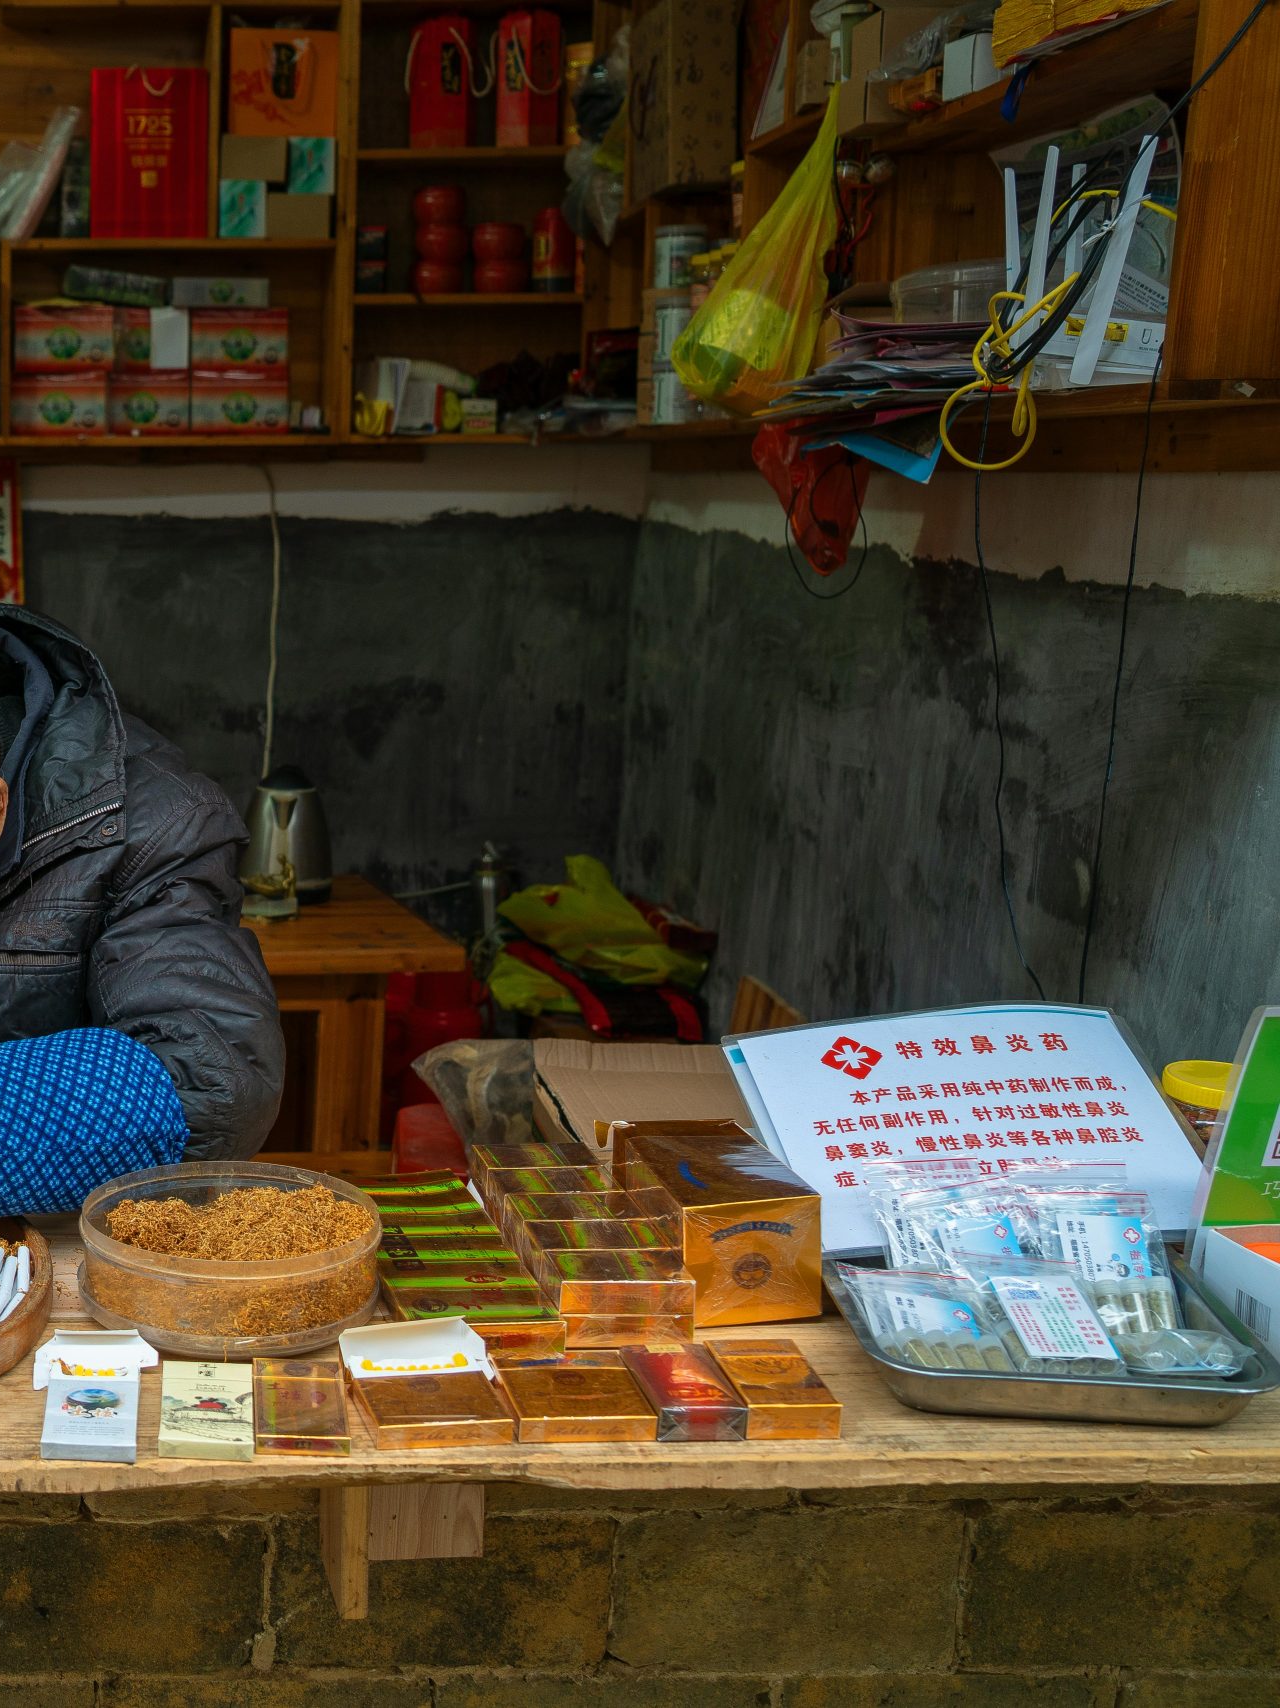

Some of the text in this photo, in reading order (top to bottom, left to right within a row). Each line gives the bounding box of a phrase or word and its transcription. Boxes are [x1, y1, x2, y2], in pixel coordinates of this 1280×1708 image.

[126, 114, 173, 136] 1725
[895, 1032, 1068, 1060] 特效鼻炎药
[850, 1076, 1127, 1106] 本产品采用纯中药制作而成，
[813, 1100, 1129, 1136] 无任何副作用，针对过敏性鼻炎
[824, 1126, 1144, 1162] 鼻窦炎，慢性鼻炎等各种鼻腔炎
